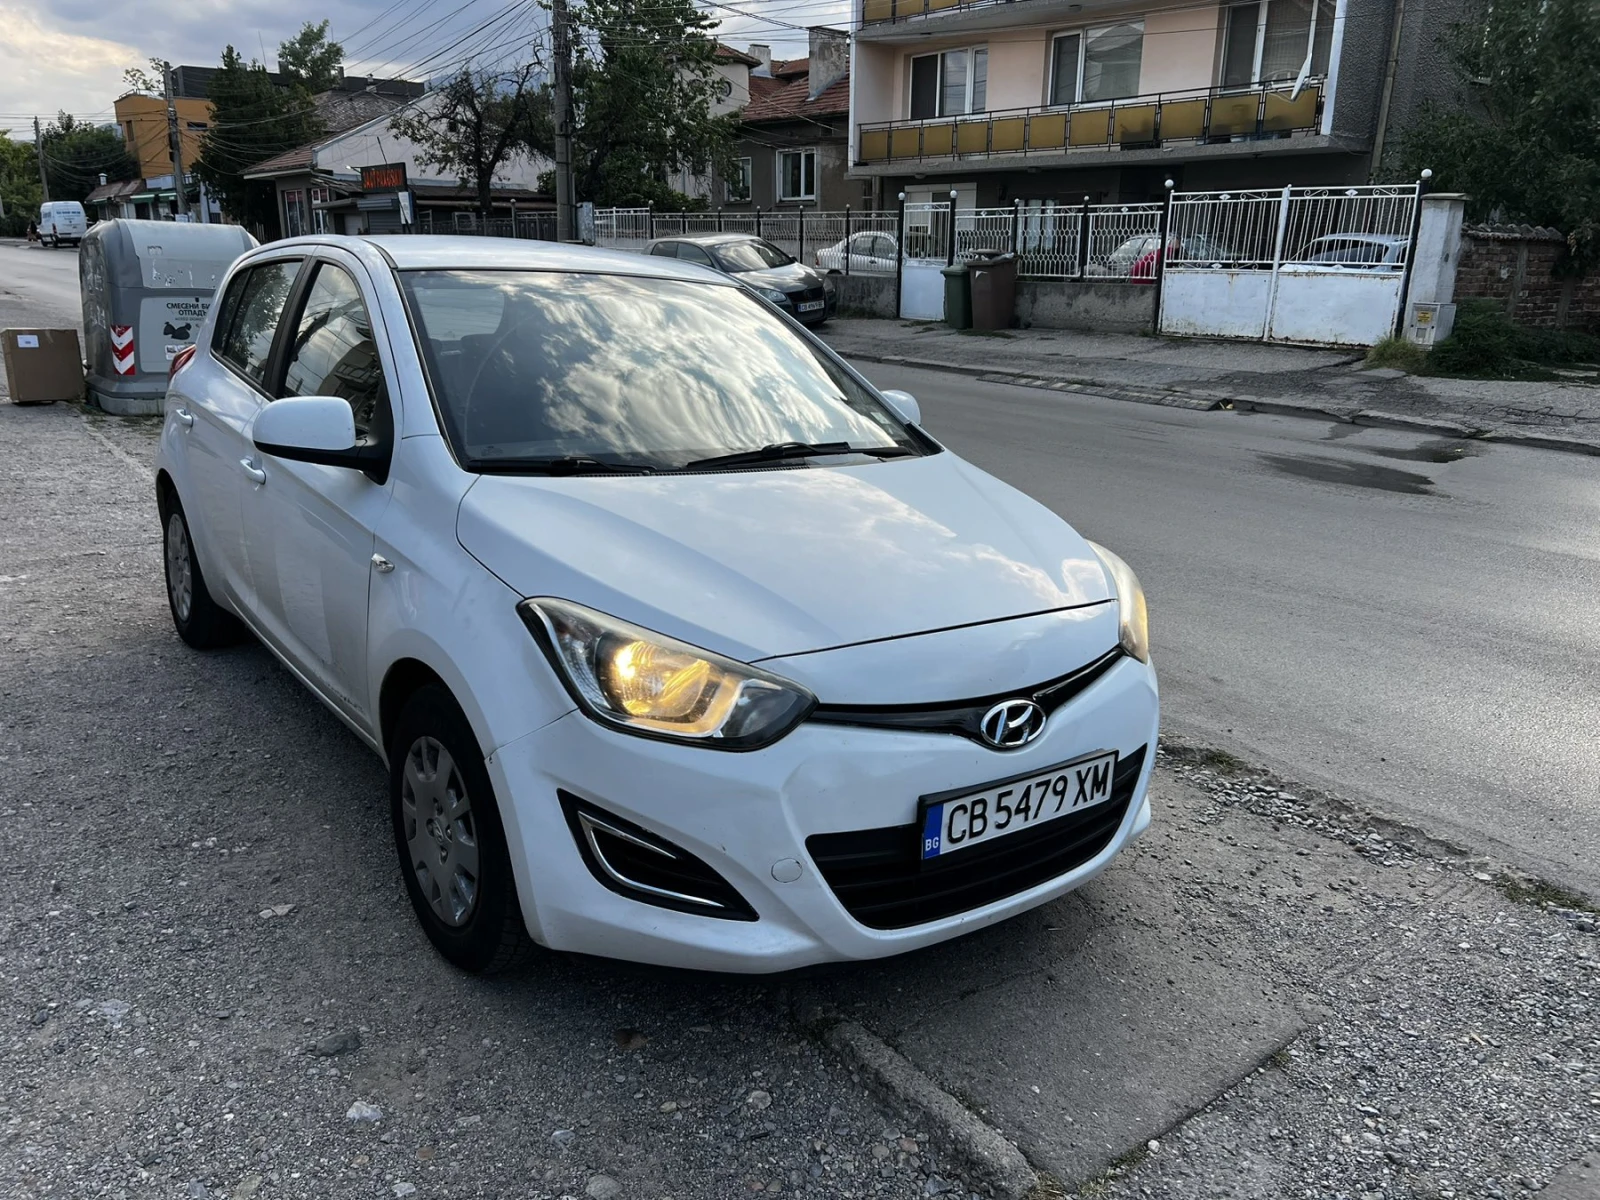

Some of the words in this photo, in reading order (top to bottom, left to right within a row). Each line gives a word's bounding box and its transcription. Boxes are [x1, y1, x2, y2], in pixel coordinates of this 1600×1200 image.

[948, 797, 988, 844] CB
[995, 774, 1068, 829] 5479
[1072, 761, 1110, 807] XM
[925, 836, 939, 851] BG
